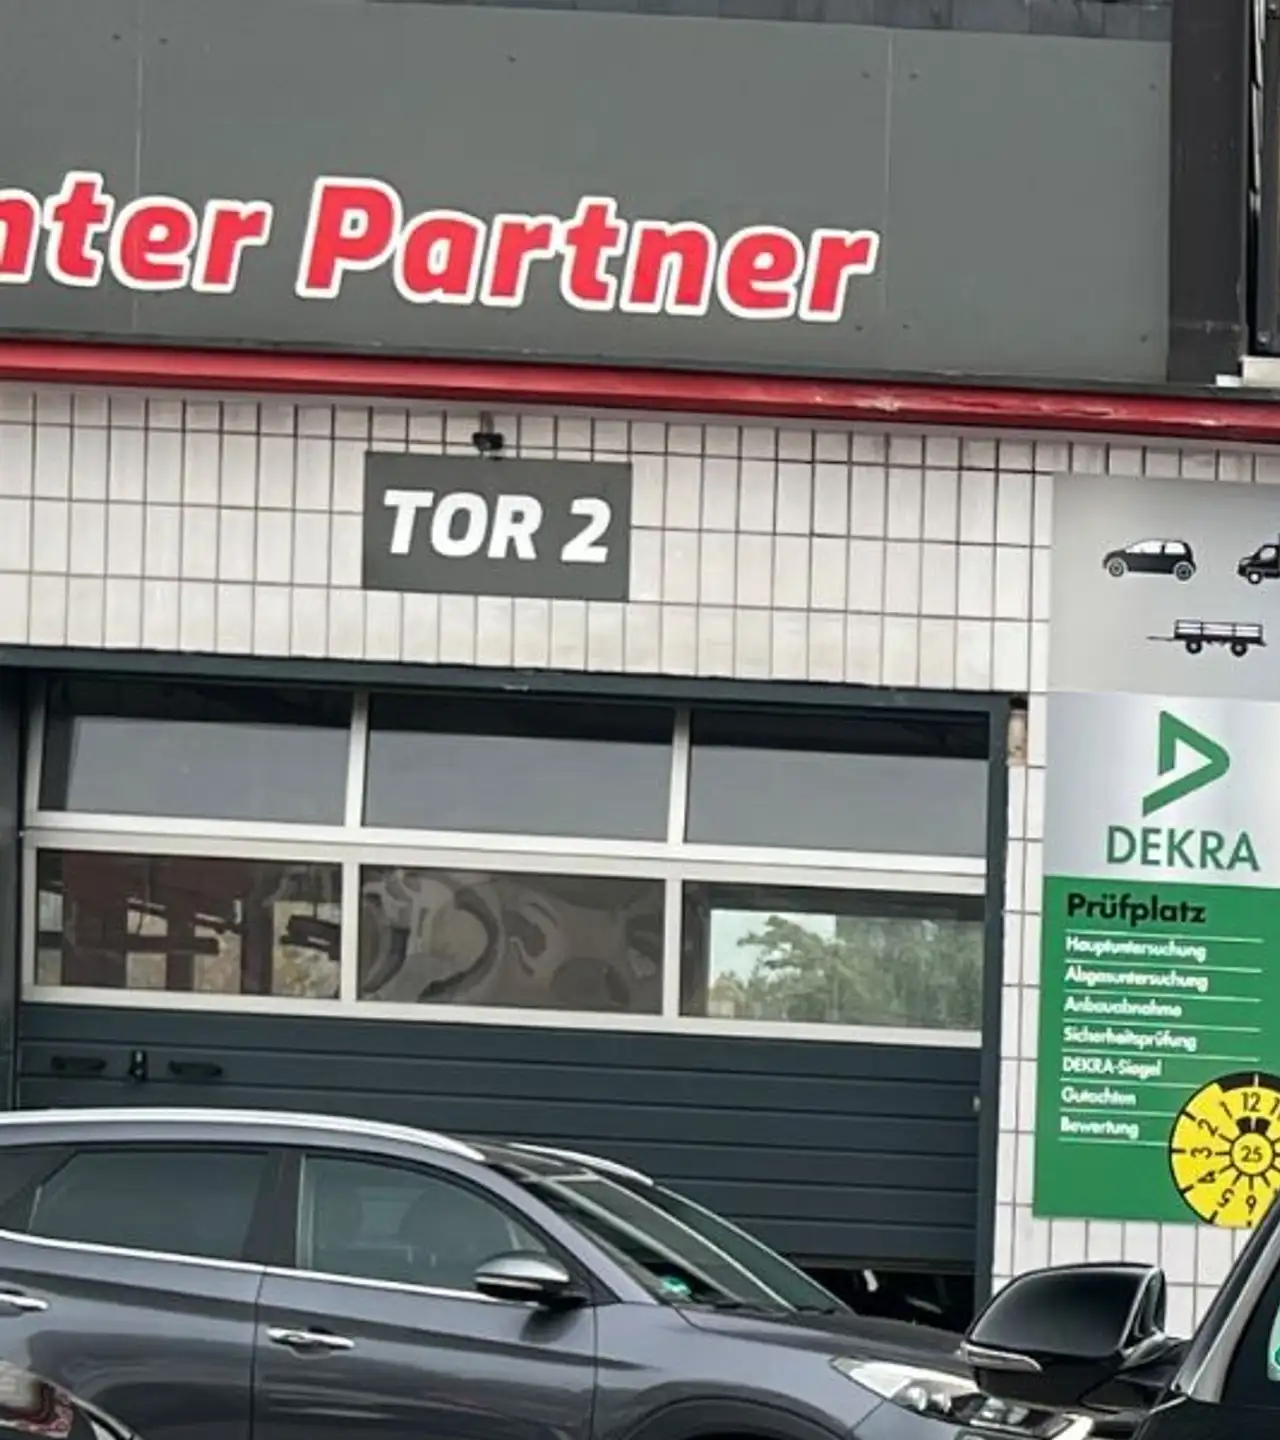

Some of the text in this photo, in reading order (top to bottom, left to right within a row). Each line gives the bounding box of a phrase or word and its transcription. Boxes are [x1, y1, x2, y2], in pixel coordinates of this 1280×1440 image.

[296, 175, 880, 322] Partner
[384, 489, 612, 563] TOR 2
[1106, 825, 1260, 872] DEKRA
[1066, 892, 1208, 928] Prüfplatz
[1065, 936, 1208, 963] Hauptuntersuchung
[1241, 1092, 1260, 1112] 12
[1060, 1115, 1139, 1139] Bewertung
[1198, 1118, 1219, 1137] 2
[1190, 1147, 1213, 1159] 3
[1241, 1145, 1263, 1162] 25
